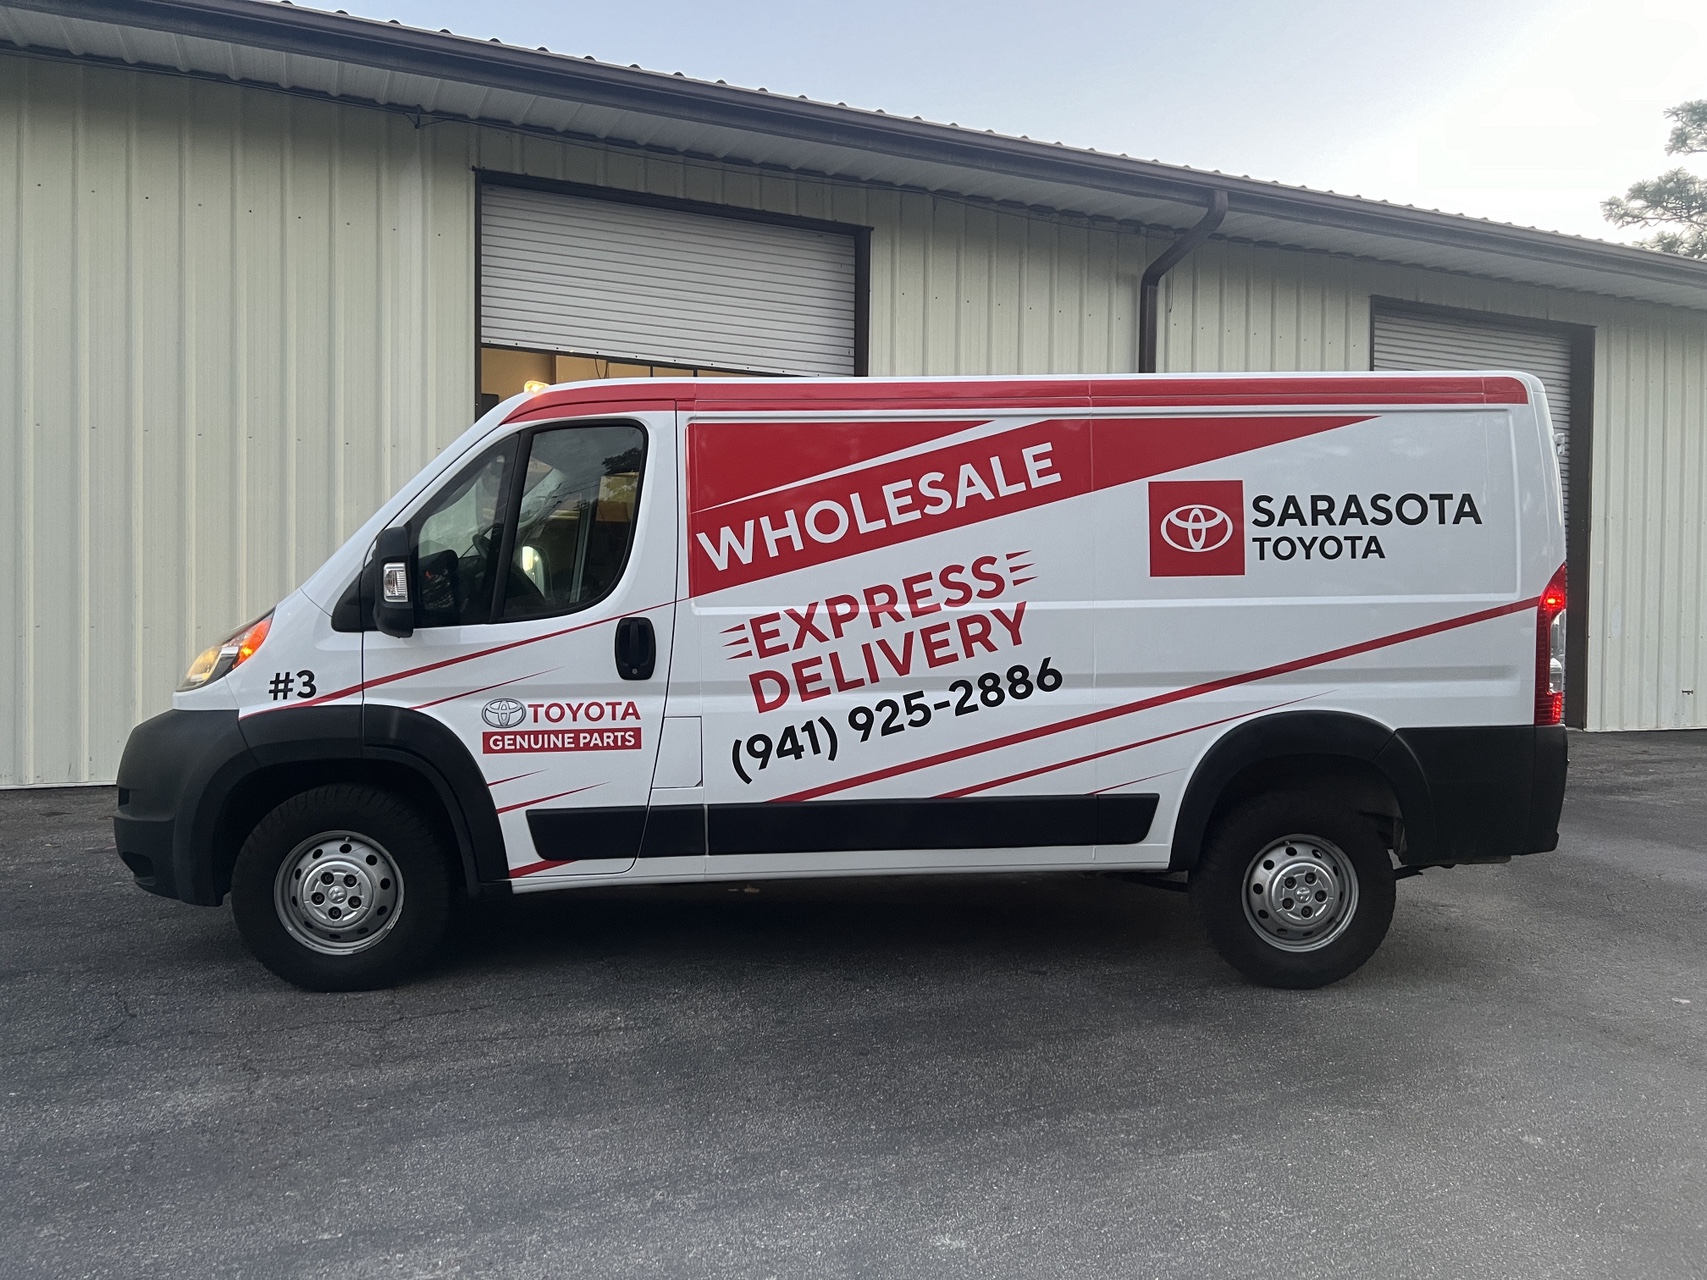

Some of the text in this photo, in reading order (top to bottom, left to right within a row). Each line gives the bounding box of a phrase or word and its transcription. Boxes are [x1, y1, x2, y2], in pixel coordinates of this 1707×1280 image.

[696, 441, 1062, 572] WHOLESALE
[1251, 493, 1482, 527] SARASOTA
[1252, 535, 1386, 561] TOYOTA
[748, 555, 1006, 660] EXPRESS
[749, 601, 1027, 714] DELIVERY
[268, 669, 317, 701] #3
[528, 701, 641, 724] TOYOTA
[731, 656, 1063, 785] (941) 925-2886
[489, 731, 636, 750] GENUINE PARTS
